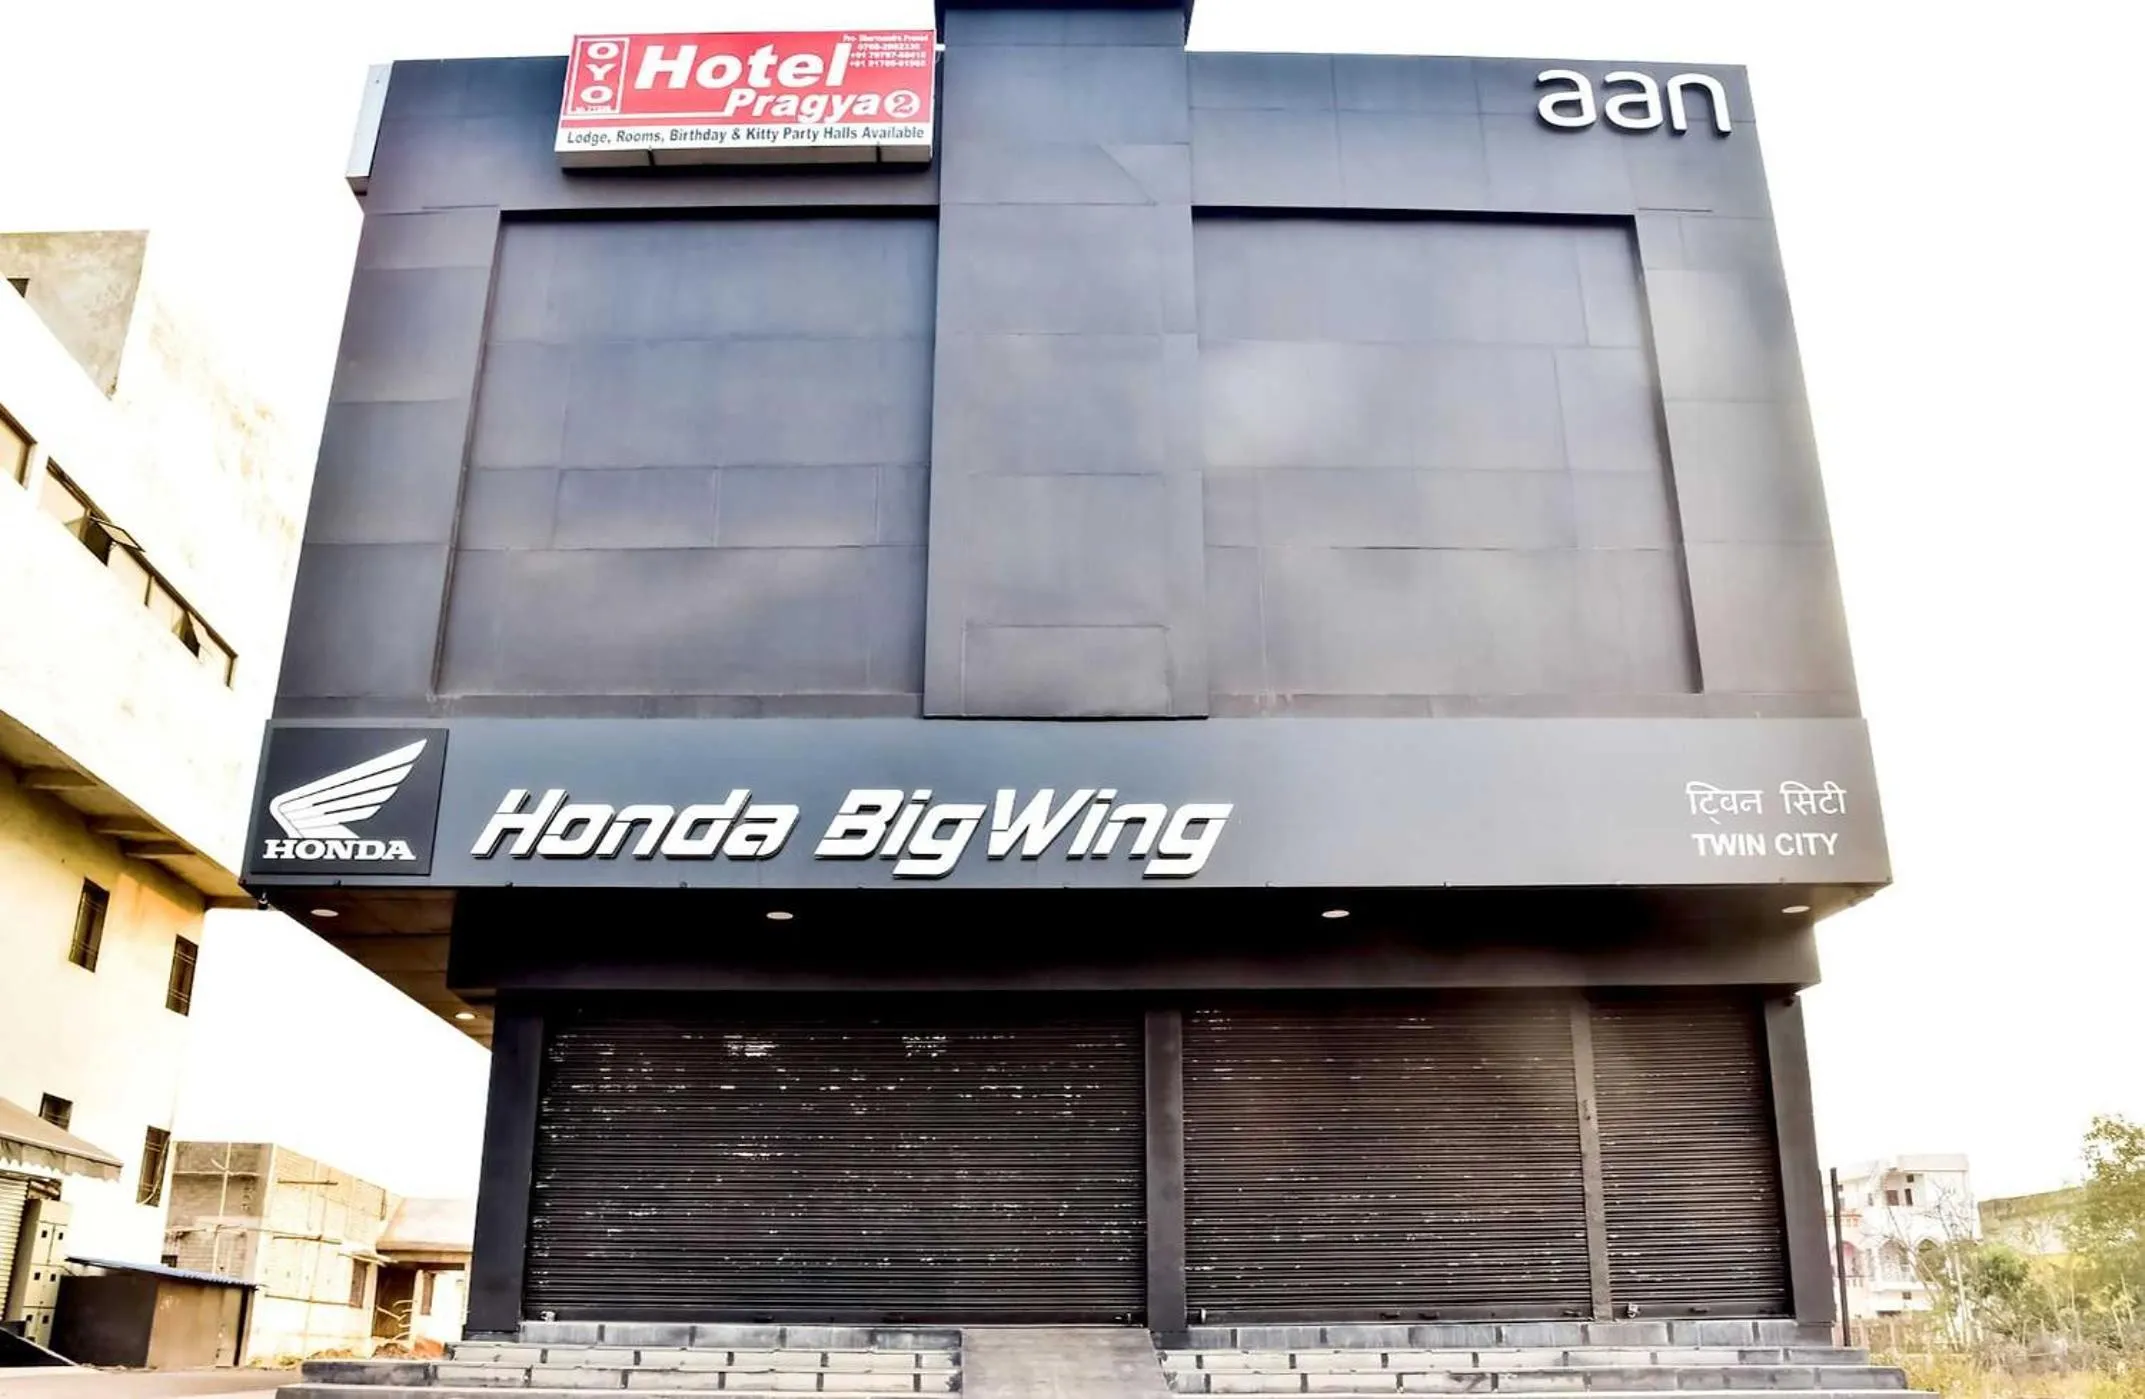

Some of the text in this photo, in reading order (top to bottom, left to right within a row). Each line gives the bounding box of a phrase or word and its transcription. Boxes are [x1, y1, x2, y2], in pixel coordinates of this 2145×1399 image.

[580, 42, 620, 104] OYO
[634, 43, 850, 89] Hotel
[723, 88, 880, 123] Pragya
[1536, 69, 1732, 136] aan
[567, 125, 925, 146] Lodge, Rooms, Birthday & Kitty Party Halls Available
[1779, 780, 1847, 816] सिटी
[470, 789, 801, 861] Honda
[262, 839, 417, 861] HONDA
[1691, 832, 1839, 856] TWIN CITY
